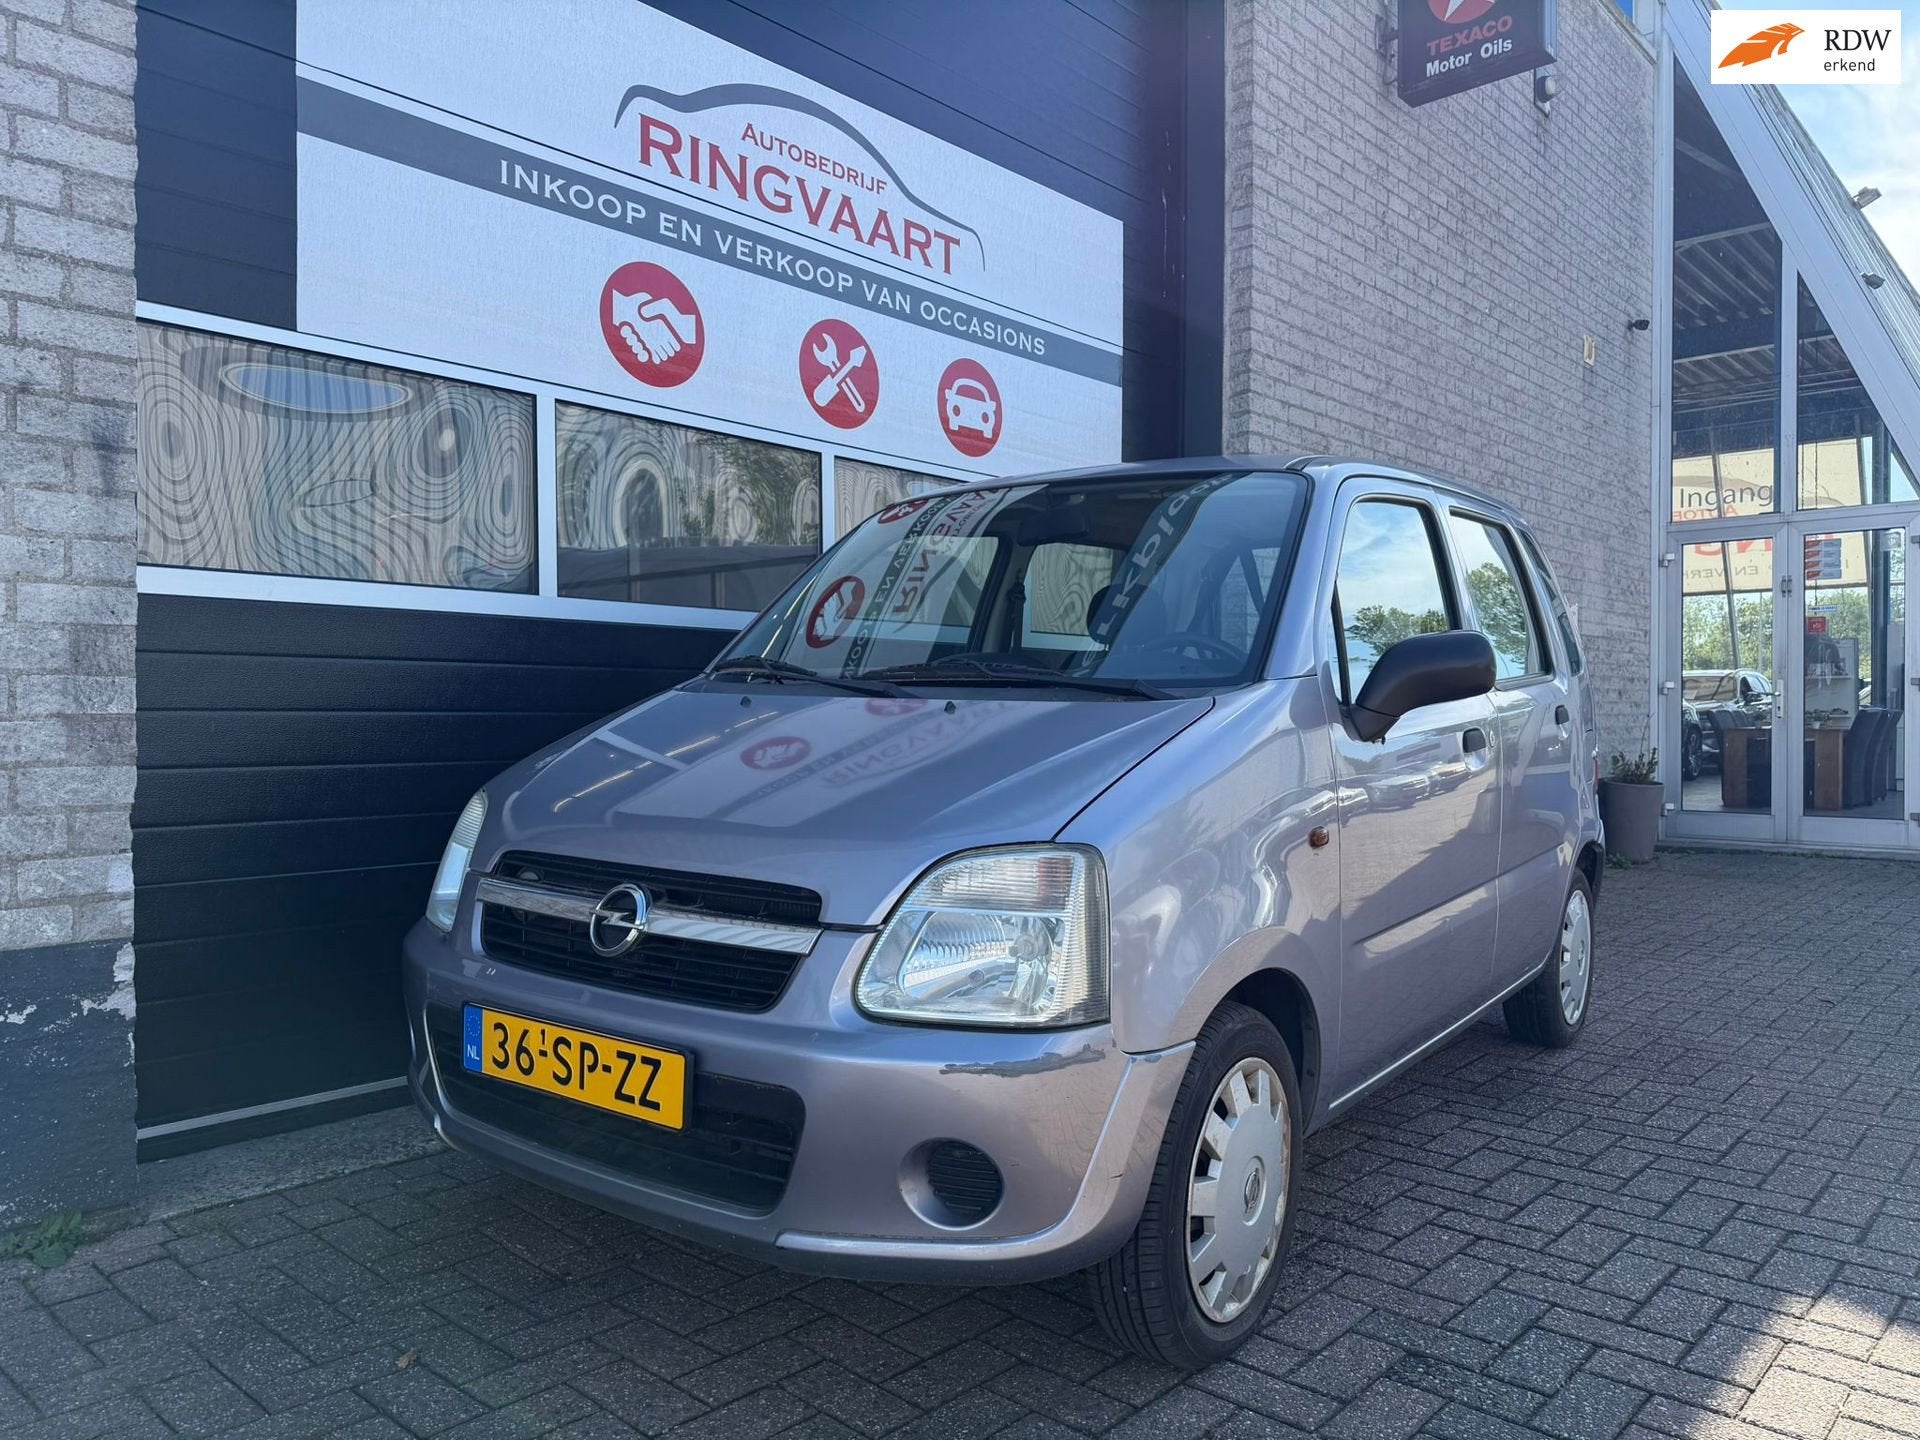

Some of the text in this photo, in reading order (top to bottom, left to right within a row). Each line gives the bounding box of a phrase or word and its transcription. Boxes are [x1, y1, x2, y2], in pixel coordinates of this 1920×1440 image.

[1426, 15, 1513, 56] TEXACO
[1426, 38, 1513, 77] Motor Oils
[741, 122, 887, 195] AUTOBEDRIJF
[638, 112, 961, 275] RINGVAART
[499, 159, 1046, 356] INKOOP EN VERKOOP VAN OCCASIONS
[1680, 484, 1773, 511] Ingang
[466, 1044, 481, 1062] NL
